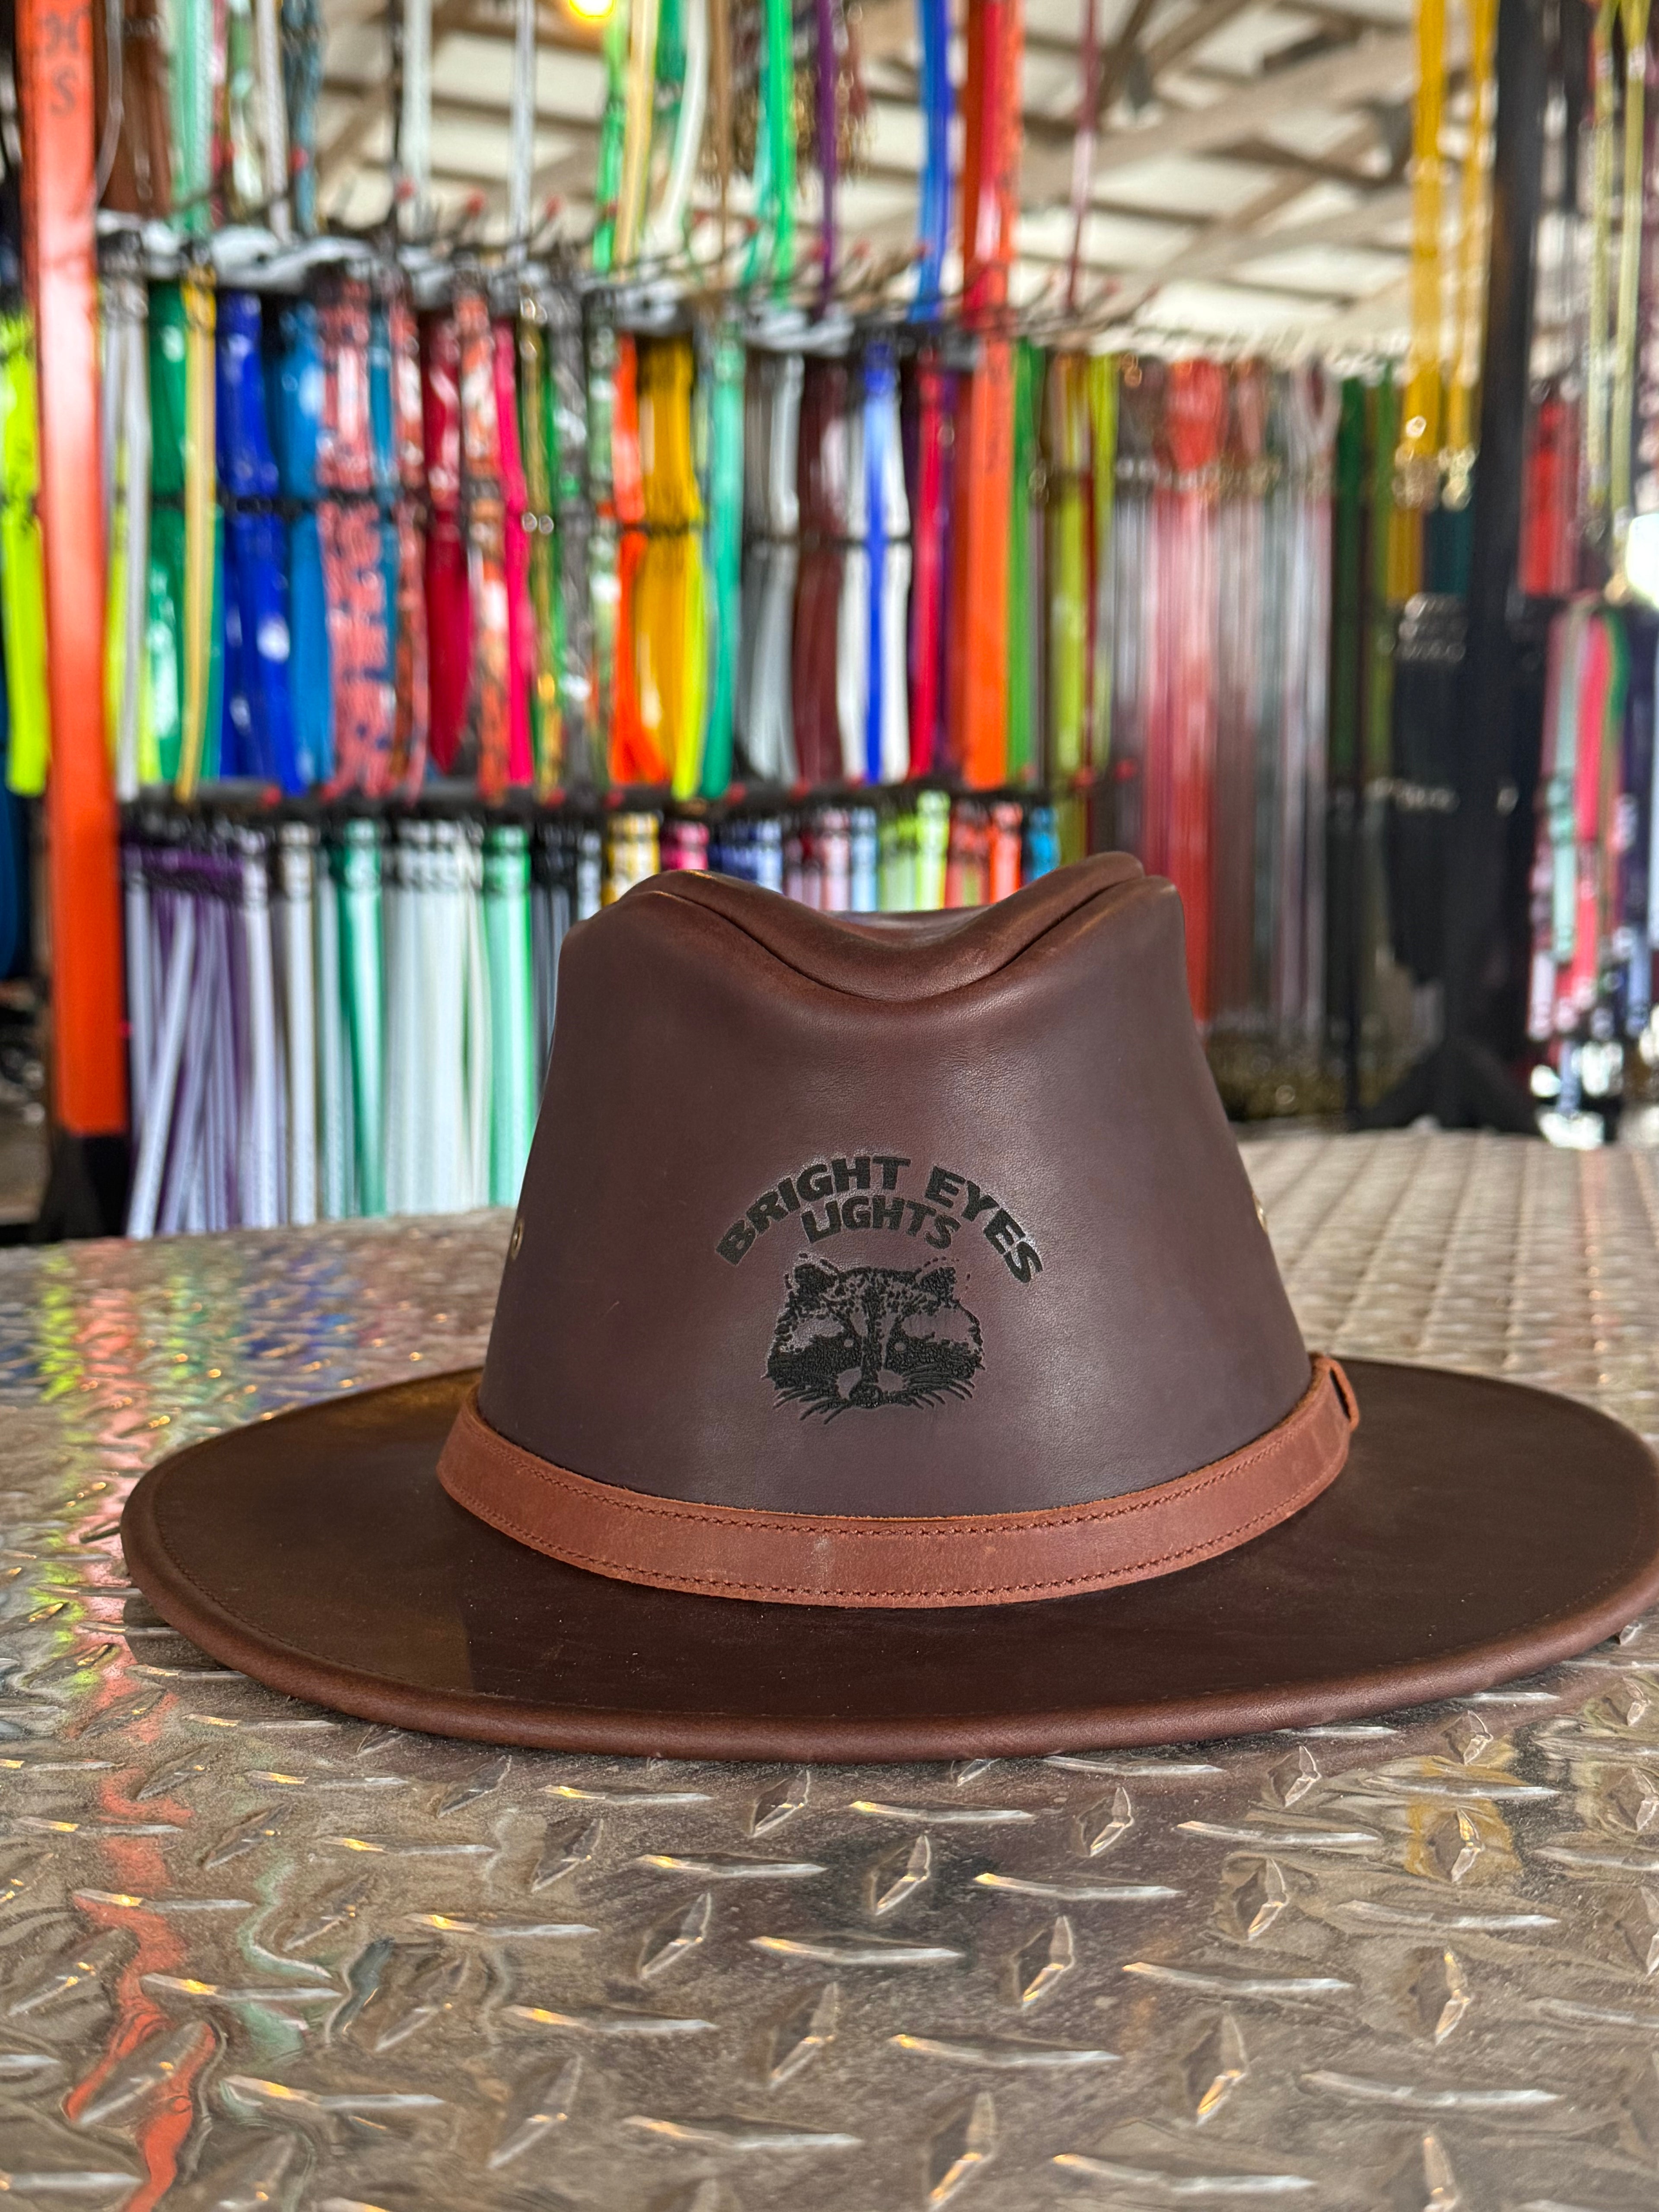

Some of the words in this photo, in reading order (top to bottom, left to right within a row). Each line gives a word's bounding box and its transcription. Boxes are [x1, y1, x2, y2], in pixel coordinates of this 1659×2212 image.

[715, 1156, 911, 1266] BRIGHT
[924, 1166, 1043, 1283] EYES
[800, 1195, 961, 1249] LIGHTS
